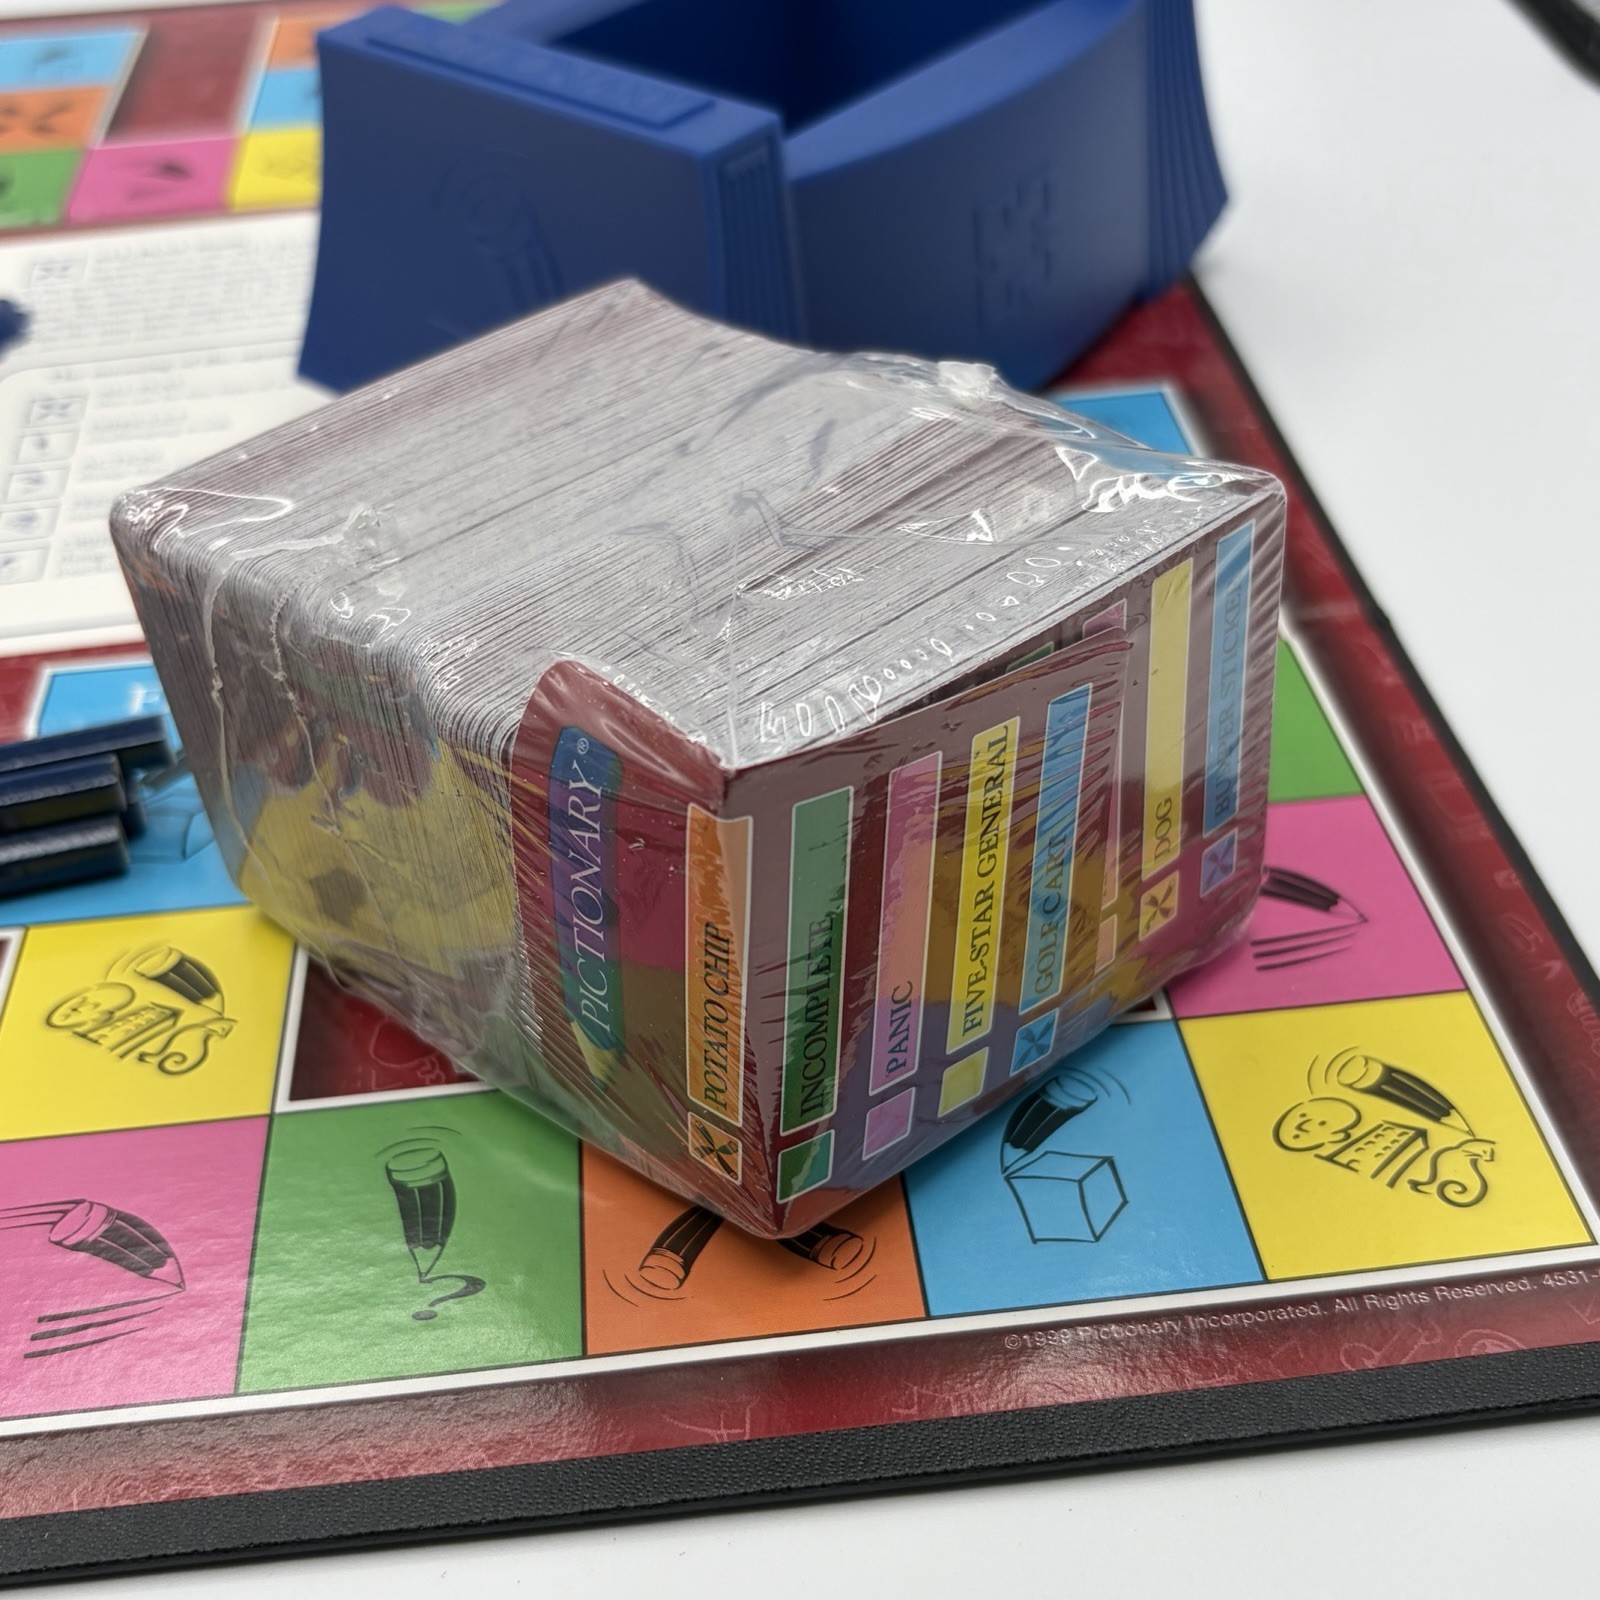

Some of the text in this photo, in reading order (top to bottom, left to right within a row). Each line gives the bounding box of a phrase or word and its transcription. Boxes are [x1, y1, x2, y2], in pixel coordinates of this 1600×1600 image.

[962, 726, 1009, 1037] FIVE-STAR GENERAL
[1154, 796, 1172, 861] DOG
[1034, 832, 1067, 996] GOLF CART
[703, 921, 730, 1110] POTATO CHIP
[885, 980, 914, 1078] PANIC
[1076, 1318, 1182, 1342] Pictionary
[1187, 1301, 1329, 1328] Incorporated.
[1334, 1298, 1360, 1313] All
[1364, 1289, 1430, 1311] Rights
[1434, 1277, 1538, 1301] Reserved.
